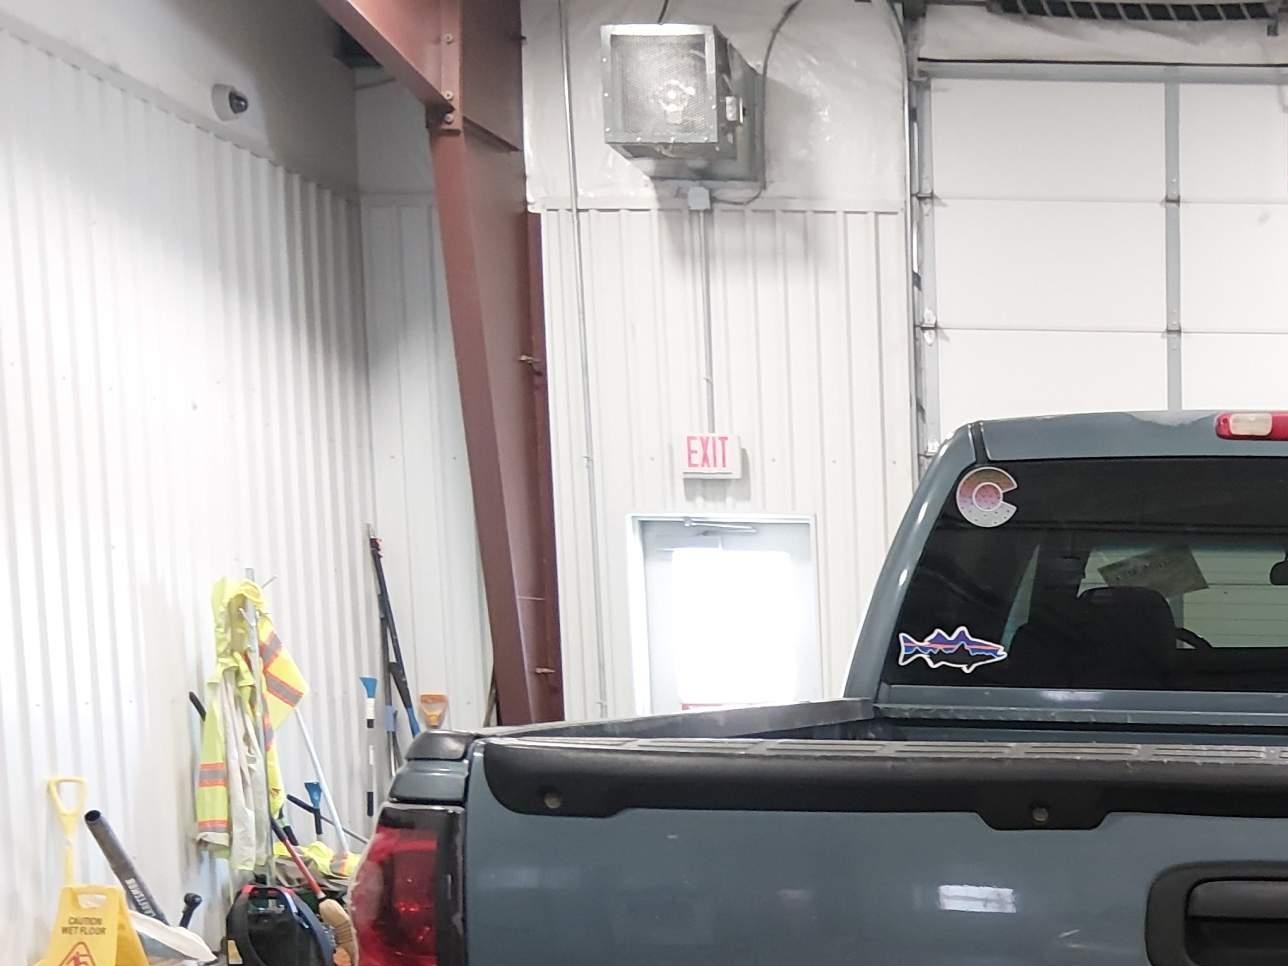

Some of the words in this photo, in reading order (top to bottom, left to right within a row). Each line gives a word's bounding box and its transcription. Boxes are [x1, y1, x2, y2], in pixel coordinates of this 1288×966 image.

[686, 436, 729, 468] EXIT
[68, 917, 102, 925] CAUTION
[61, 926, 79, 935] WET
[80, 927, 106, 935] FLOOR
